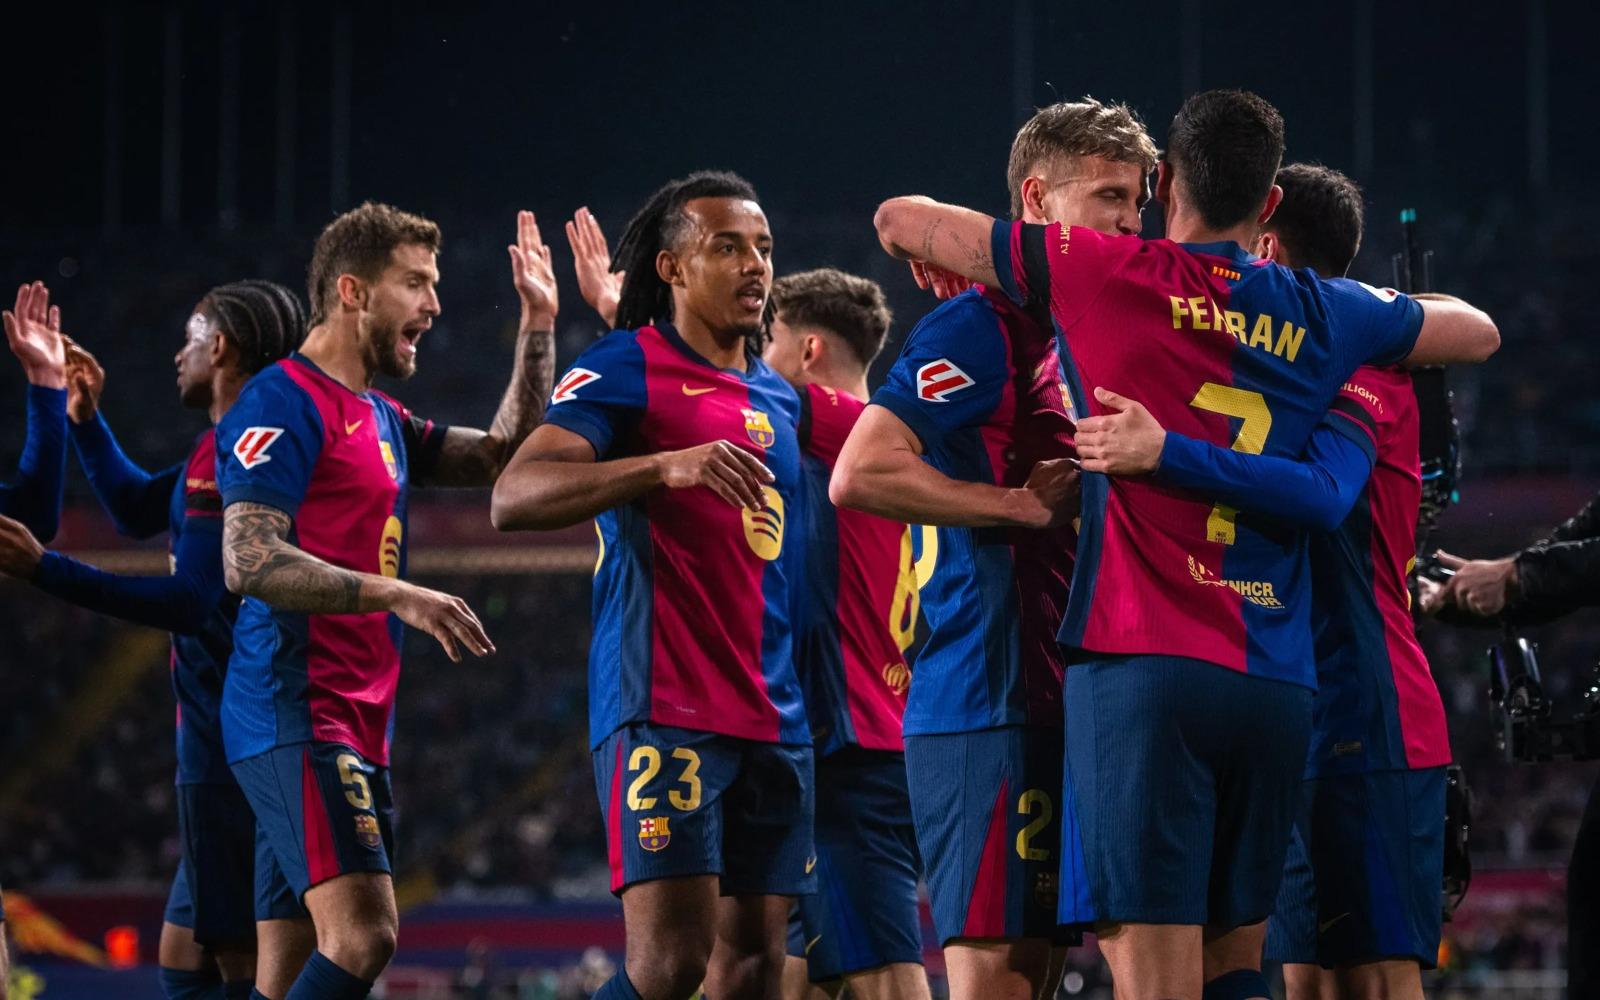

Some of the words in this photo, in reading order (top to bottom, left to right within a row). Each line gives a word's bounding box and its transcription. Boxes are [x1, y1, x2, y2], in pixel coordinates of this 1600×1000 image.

[1341, 382, 1379, 406] ILIGHT
[1189, 382, 1272, 546] 7
[1220, 580, 1274, 597] NHCR
[336, 753, 371, 810] 5
[627, 746, 702, 812] 23
[1015, 788, 1053, 860] 2
